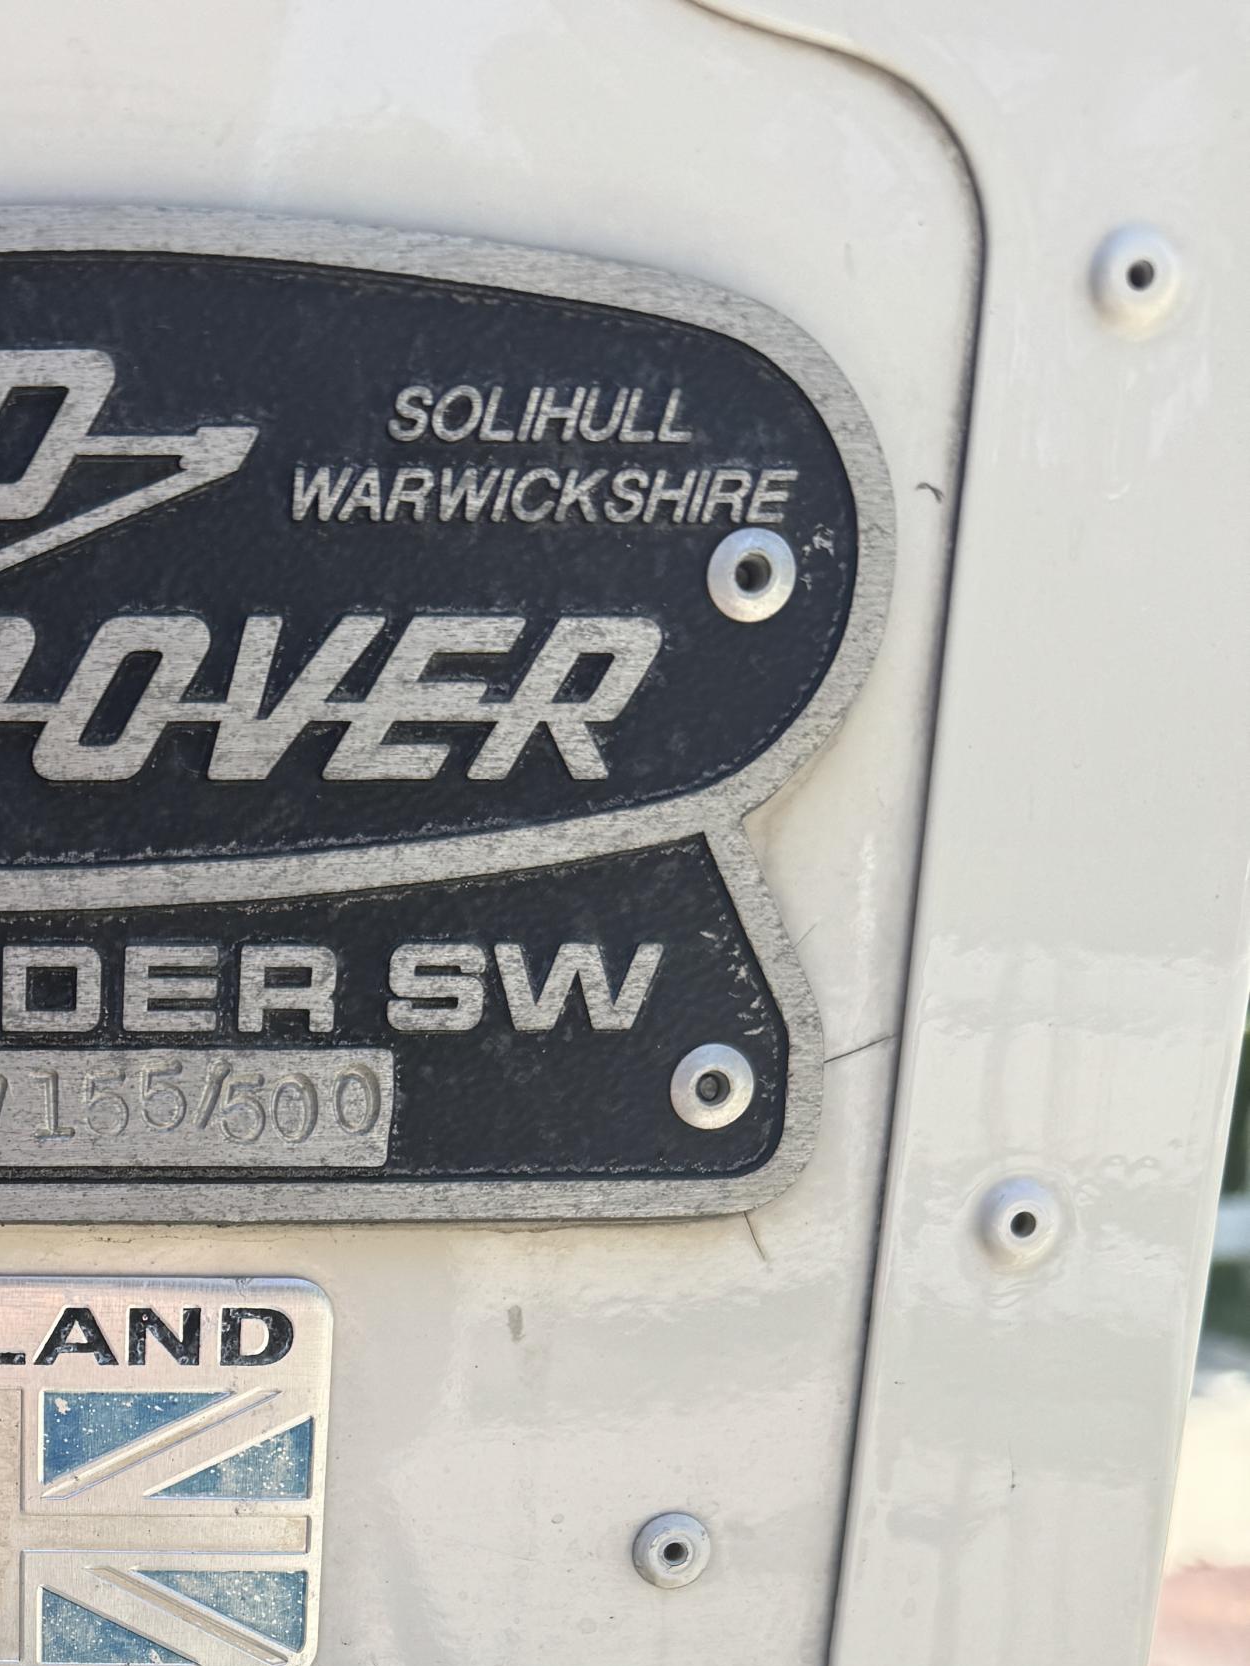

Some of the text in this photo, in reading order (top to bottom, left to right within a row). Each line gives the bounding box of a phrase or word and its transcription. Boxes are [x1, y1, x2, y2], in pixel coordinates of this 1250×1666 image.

[388, 385, 693, 443] SOLIHULL
[291, 467, 798, 524] WARWICKSHIRE
[386, 942, 664, 1032] SW
